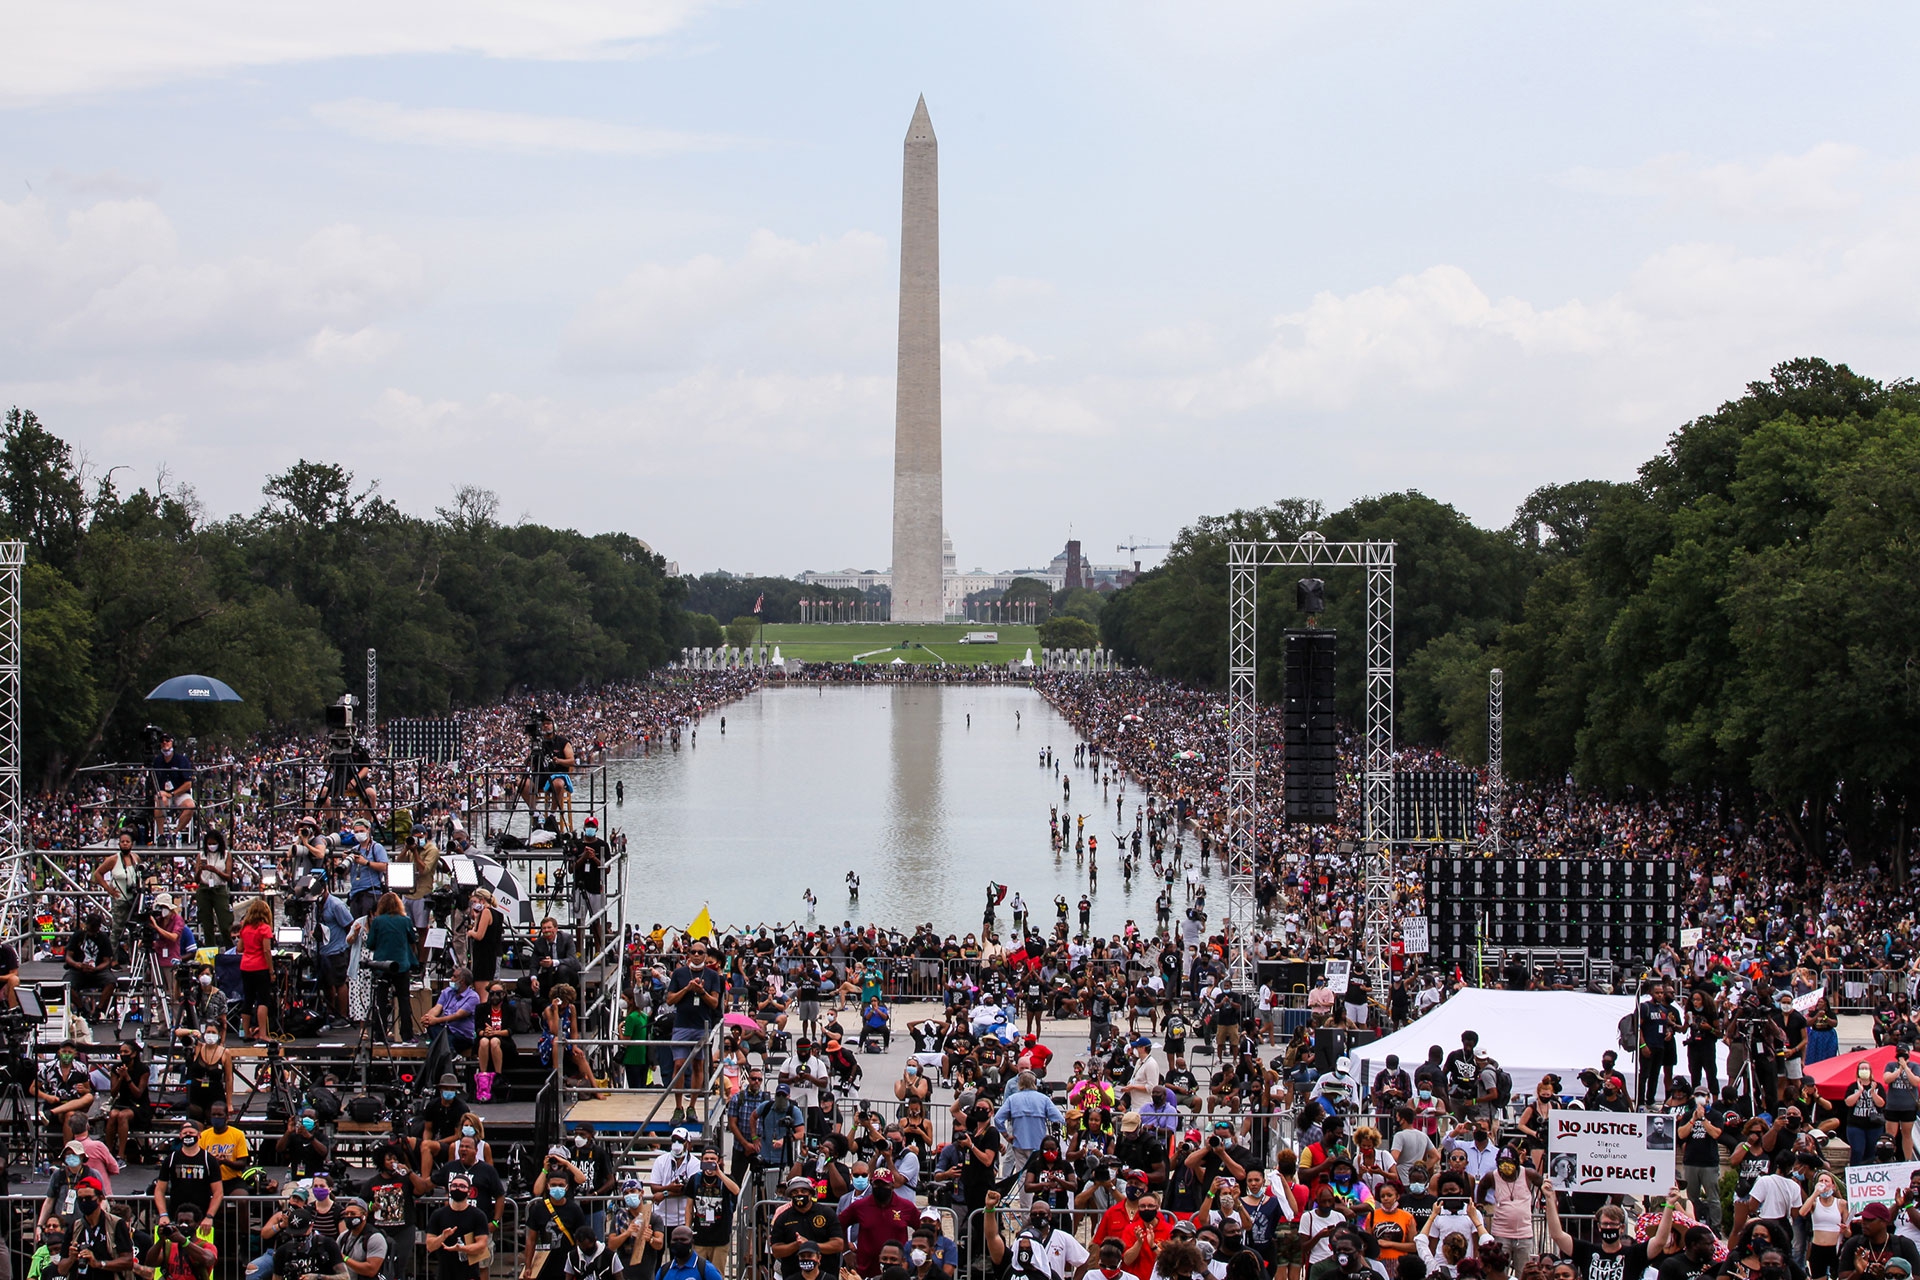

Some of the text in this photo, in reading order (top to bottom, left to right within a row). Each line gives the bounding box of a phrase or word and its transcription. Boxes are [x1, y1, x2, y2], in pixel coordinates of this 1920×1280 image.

[500, 896, 512, 905] AP
[1558, 1119, 1643, 1138] NO JUSTICE,
[1597, 1140, 1620, 1148] Silence
[1589, 1151, 1628, 1160] Compliance
[1581, 1164, 1656, 1182] NO PEACE!
[1849, 1171, 1891, 1184] BLACK
[1850, 1185, 1886, 1198] LIVES
